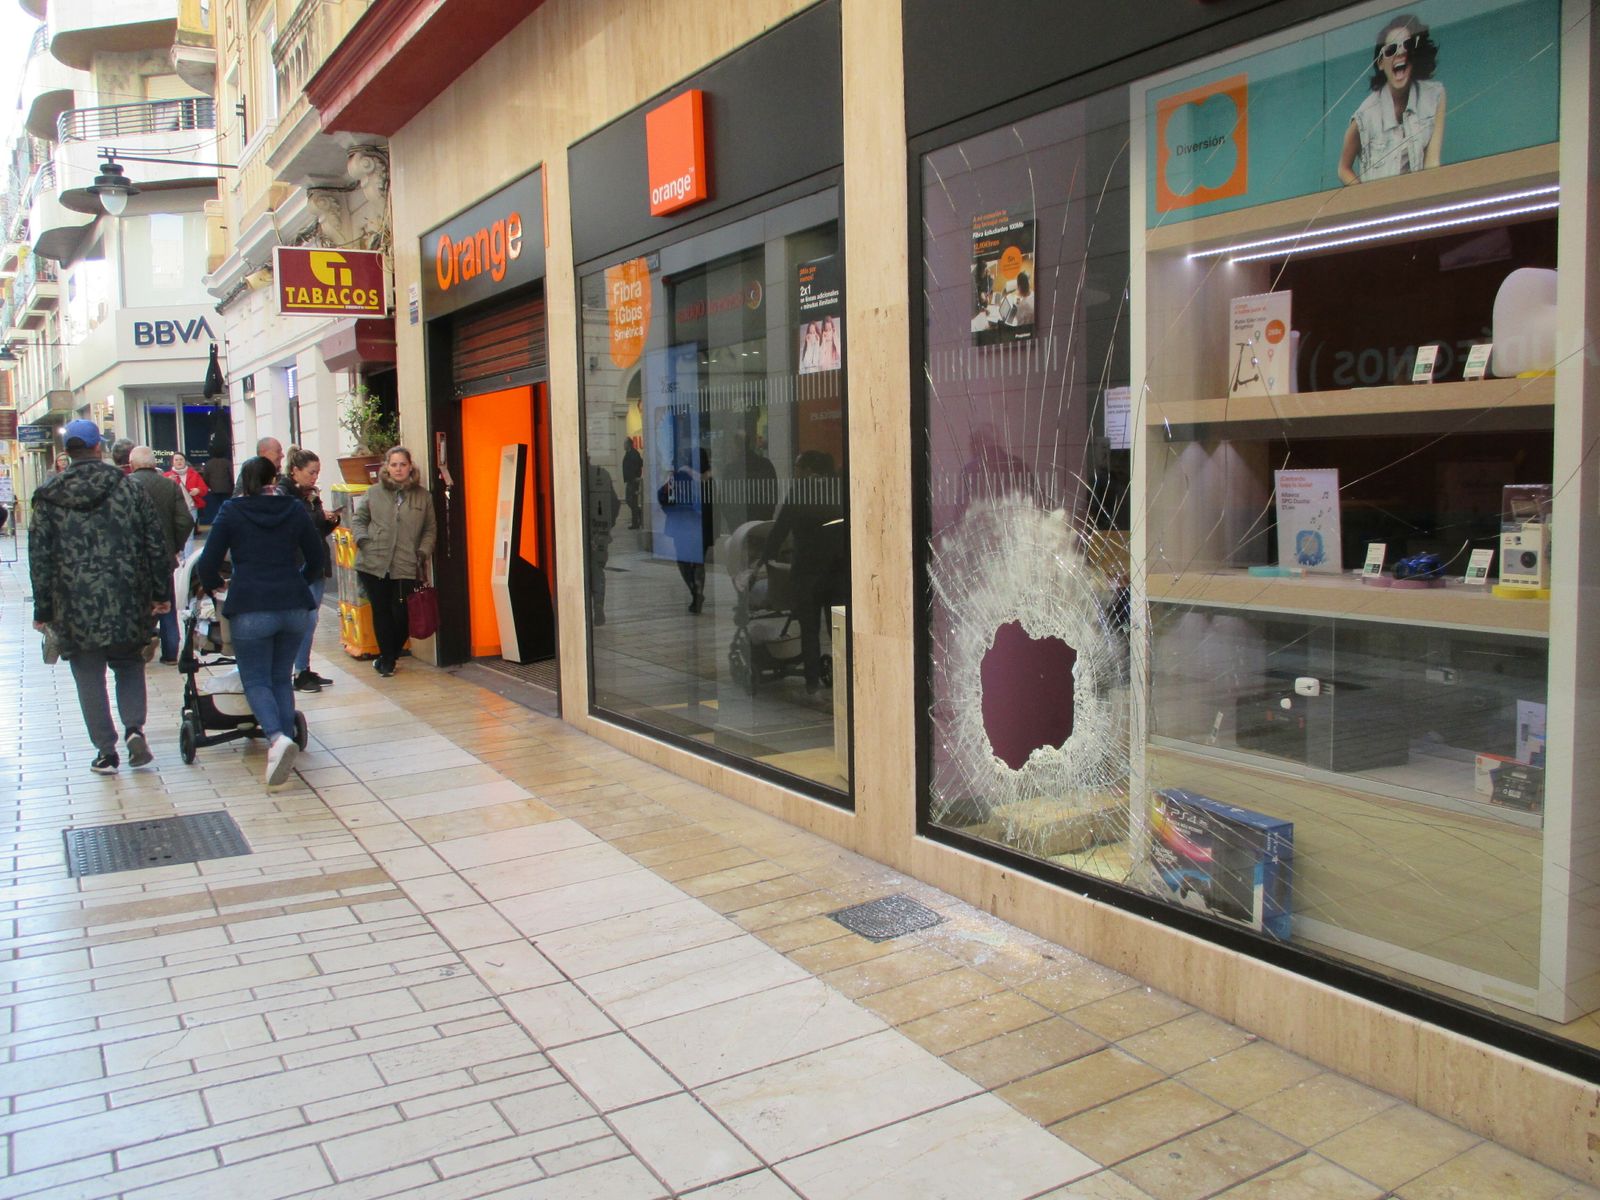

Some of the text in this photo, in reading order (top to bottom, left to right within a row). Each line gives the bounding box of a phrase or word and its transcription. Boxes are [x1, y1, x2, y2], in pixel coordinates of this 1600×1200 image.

[1176, 136, 1226, 156] Diversión
[652, 174, 691, 205] orange
[436, 211, 522, 291] Orange
[285, 286, 379, 306] TABACOS
[613, 280, 642, 305] Fibra
[800, 284, 811, 297] 2x1
[615, 305, 643, 326] 1Gbps
[134, 315, 216, 347] BBVA
[152, 450, 175, 459] Oficina
[1171, 808, 1197, 825] PS4
